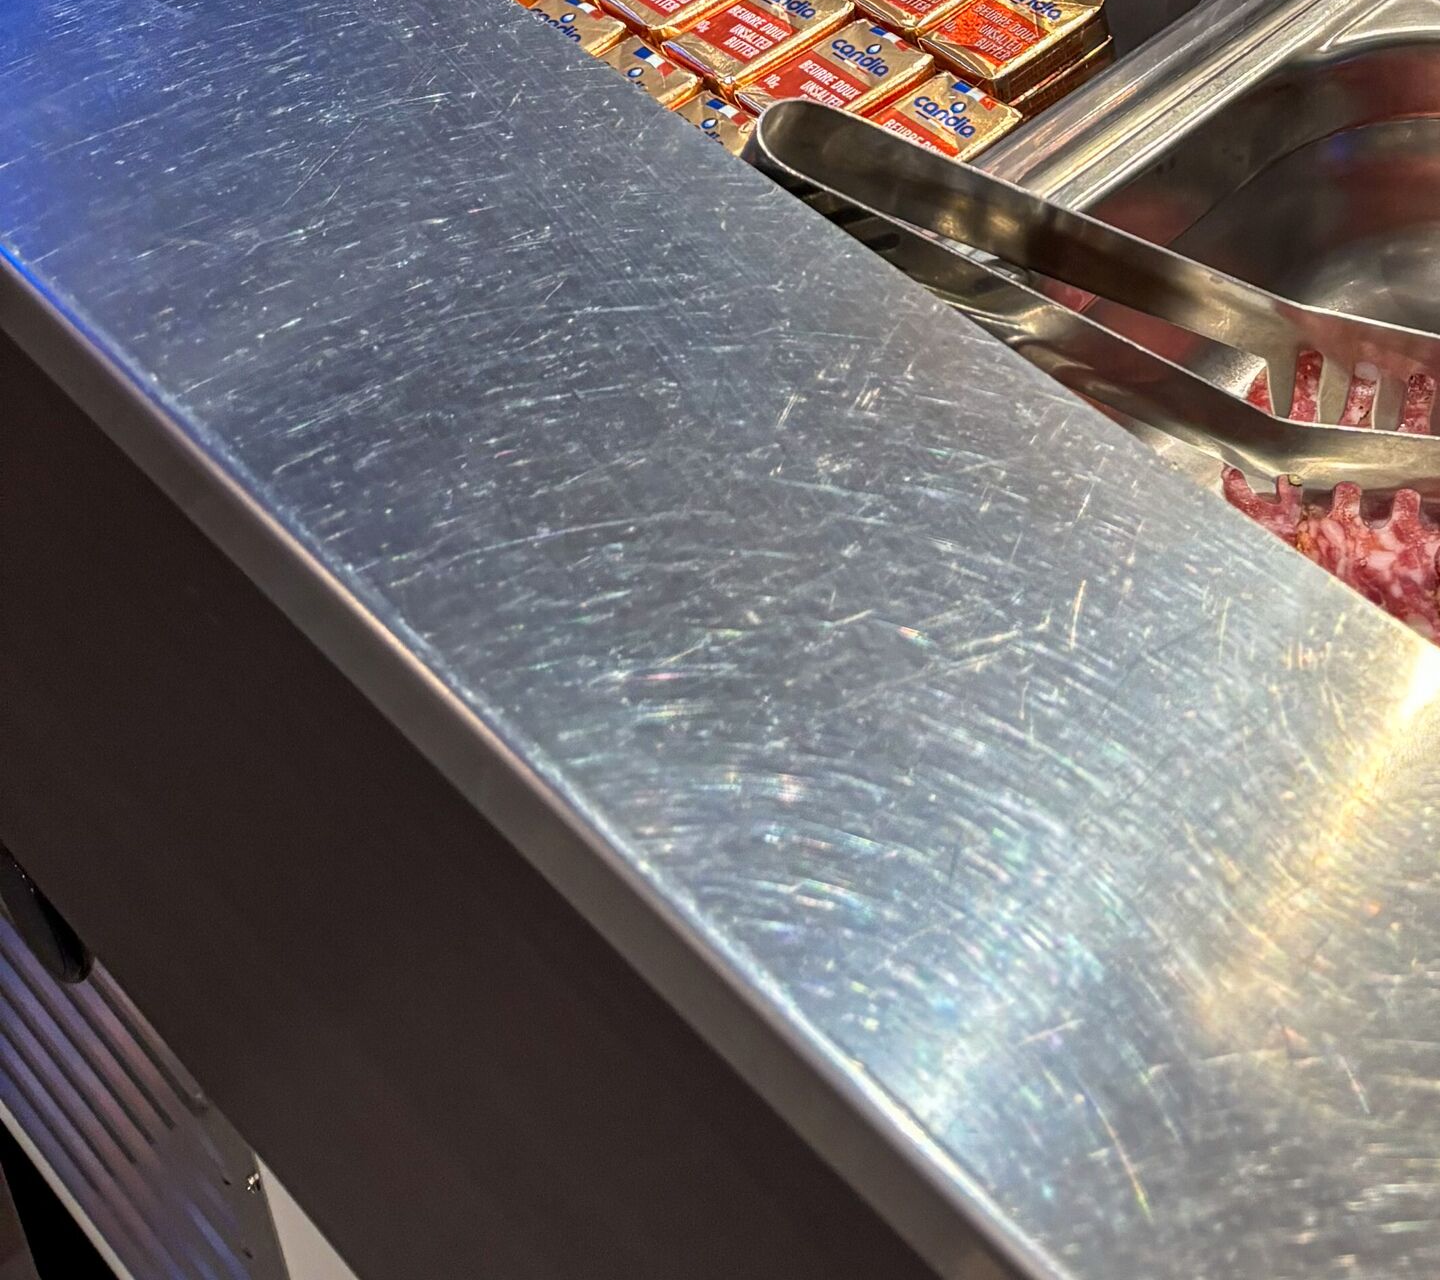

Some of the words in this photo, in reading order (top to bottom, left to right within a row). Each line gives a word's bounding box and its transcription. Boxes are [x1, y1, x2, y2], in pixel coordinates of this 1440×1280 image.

[831, 39, 889, 77] candia
[798, 59, 839, 86] BEURRE
[830, 80, 862, 101] DOUX
[913, 94, 976, 139] candia
